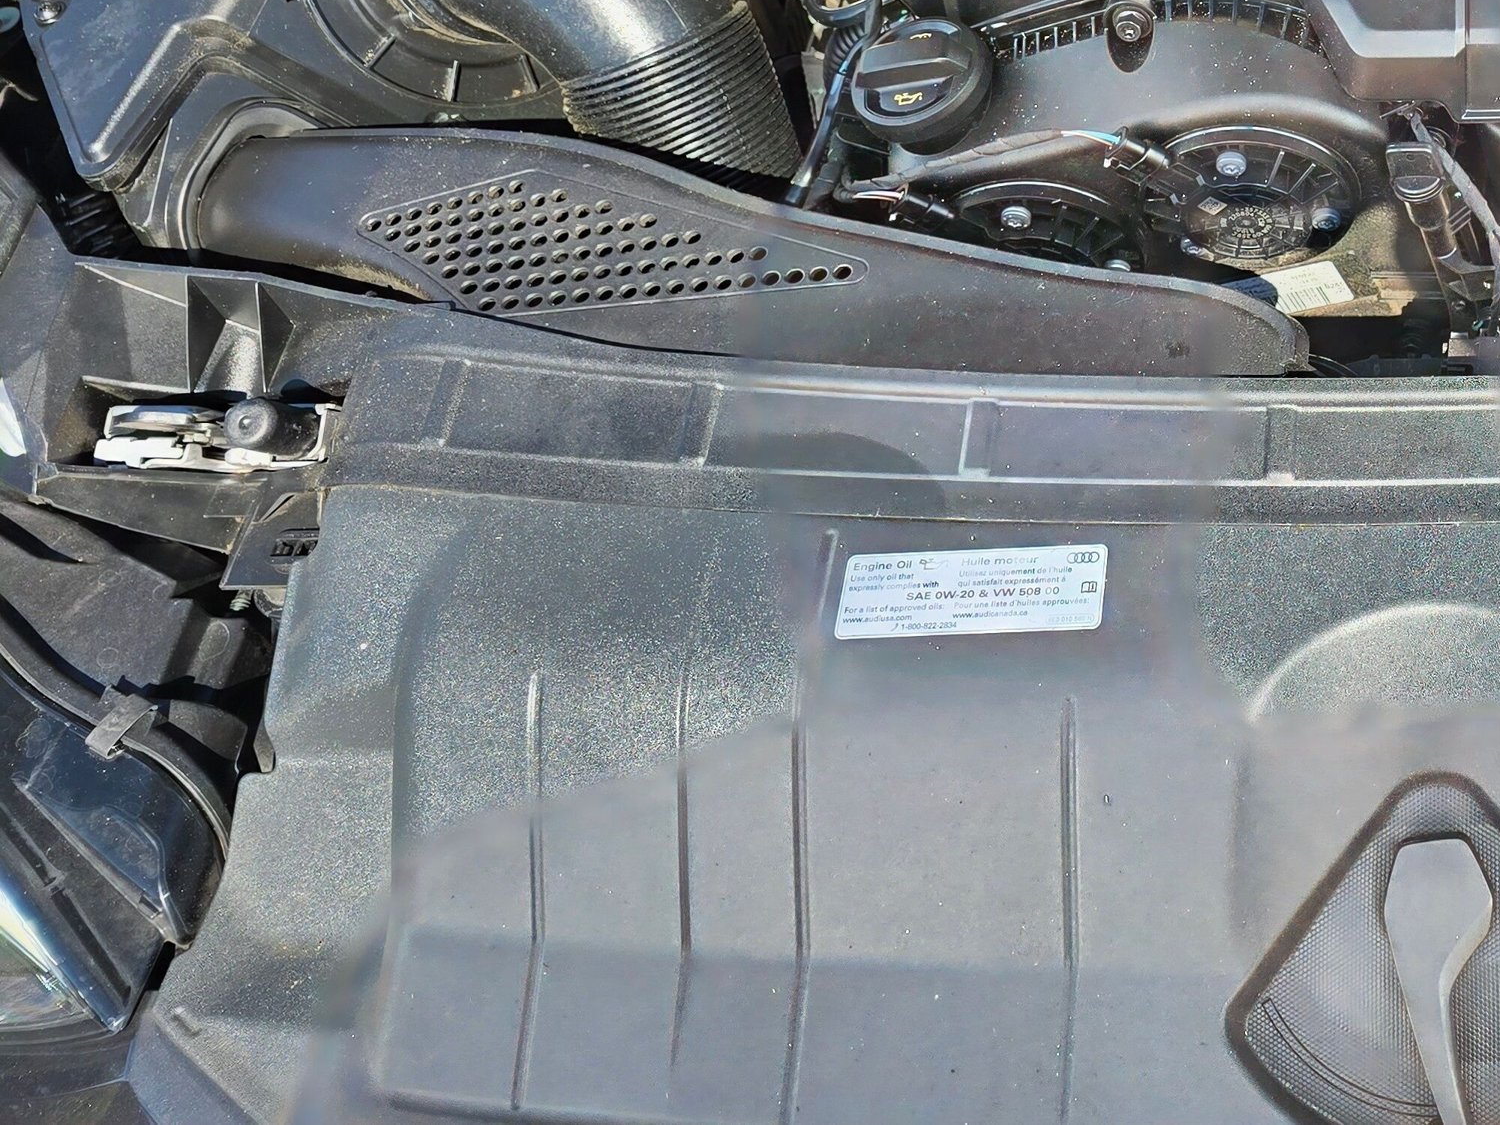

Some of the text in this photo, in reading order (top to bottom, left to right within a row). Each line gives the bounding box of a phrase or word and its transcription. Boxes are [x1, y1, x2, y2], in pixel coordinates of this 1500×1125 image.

[853, 560, 912, 572] Engine Oil
[962, 557, 991, 566] Huile
[988, 568, 1036, 577] uniquement
[867, 574, 885, 583] only
[886, 573, 897, 581] oil
[957, 579, 971, 588] qui
[972, 578, 1003, 586] satisfait
[1004, 576, 1060, 586] expressément
[848, 584, 884, 592] expressly
[886, 582, 921, 591] complies
[906, 586, 1060, 601] SAE 0W-20 & VW 508 00
[844, 606, 858, 614] For
[889, 604, 927, 614] approved
[842, 614, 913, 624] www.audiusa.com
[952, 610, 1028, 619] www.audicanada.ca
[901, 621, 957, 630] 1-800-822-2834
